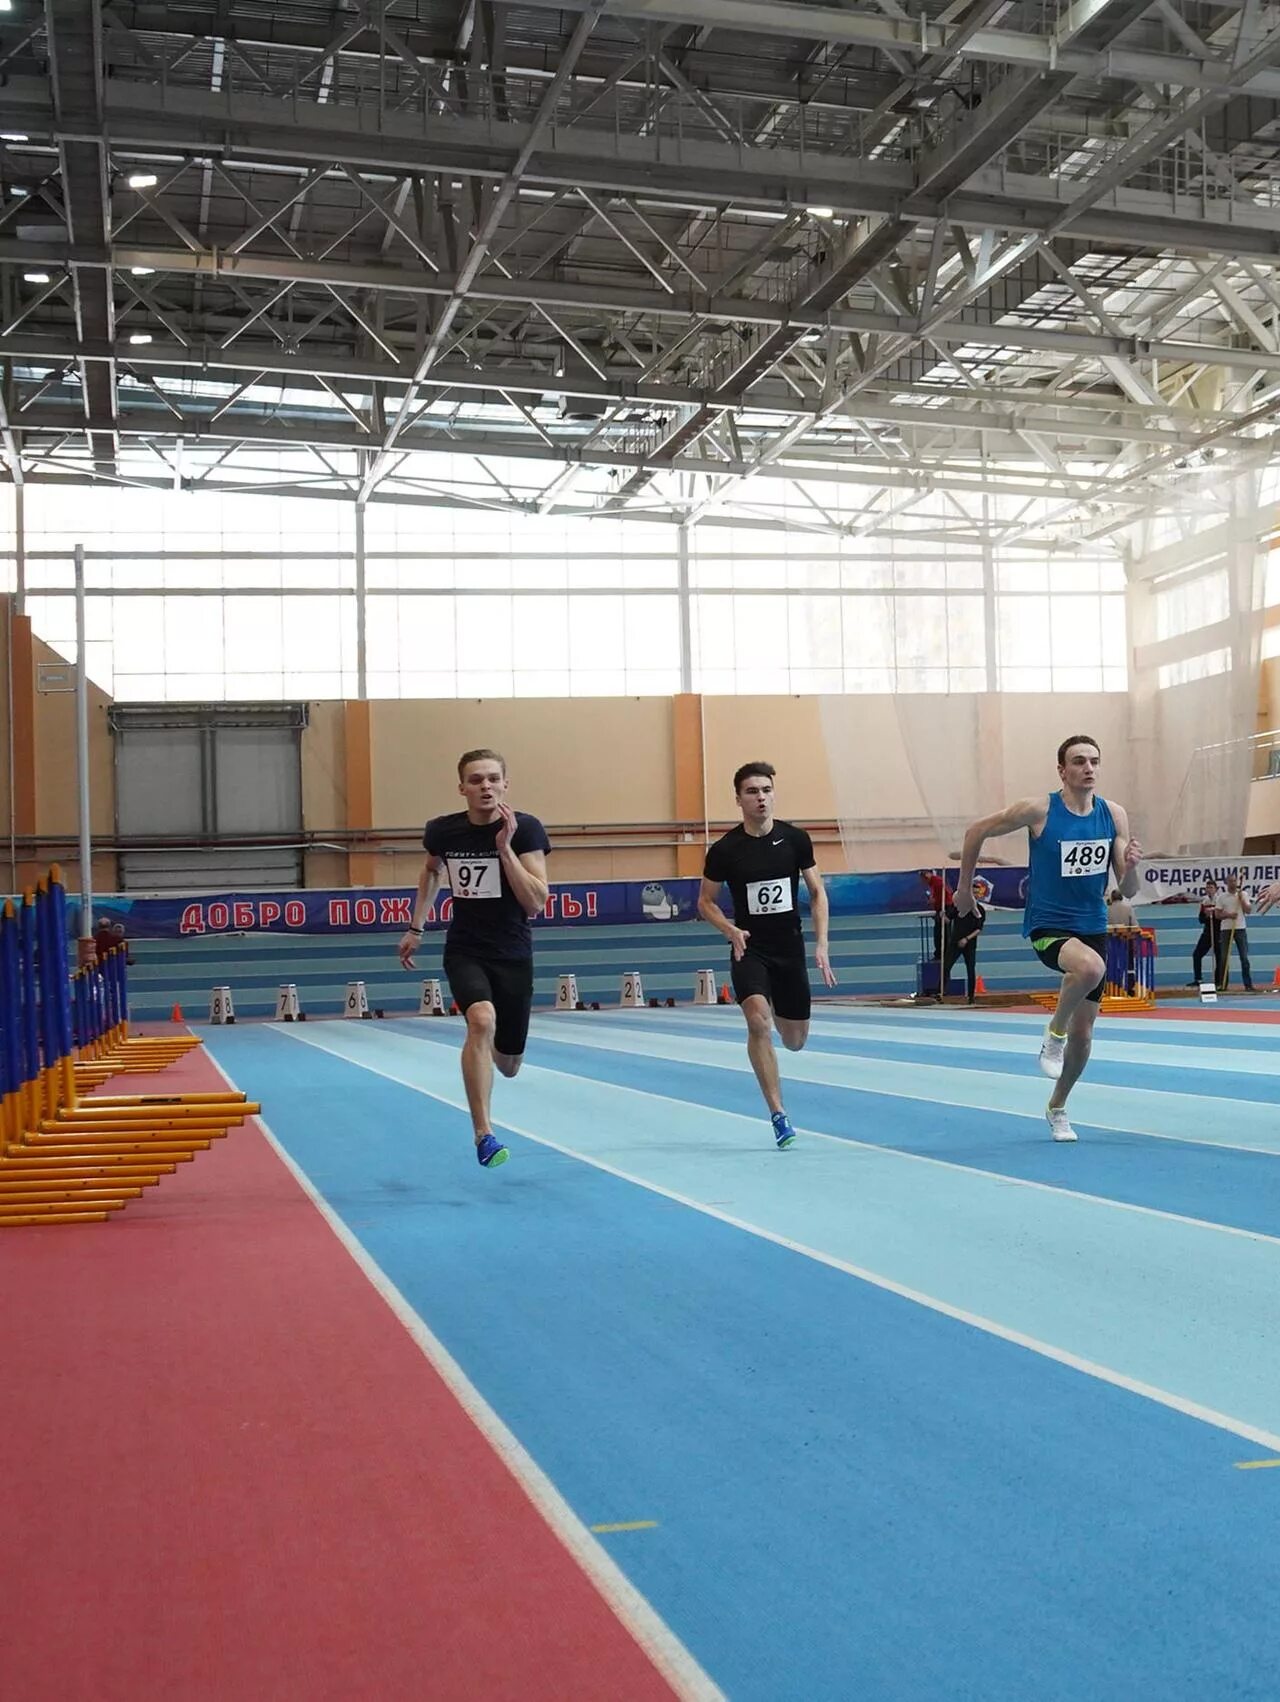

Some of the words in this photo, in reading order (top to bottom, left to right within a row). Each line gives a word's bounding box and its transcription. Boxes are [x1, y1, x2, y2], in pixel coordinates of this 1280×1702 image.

[1064, 845, 1106, 866] 489
[458, 865, 488, 888] 97
[1145, 865, 1249, 885] ФЕДЕРАЦИЯ
[758, 885, 783, 905] 62
[180, 899, 306, 934] ДОБРО
[423, 988, 431, 1005] 5
[435, 988, 441, 1005] 5
[560, 985, 567, 1001] 3
[571, 984, 576, 1000] 3
[624, 981, 632, 998] 2
[635, 982, 641, 998] 2
[213, 998, 221, 1015] 8
[226, 997, 232, 1013] 8
[280, 994, 288, 1010] 7
[348, 991, 356, 1009] 6
[360, 992, 367, 1008] 6
